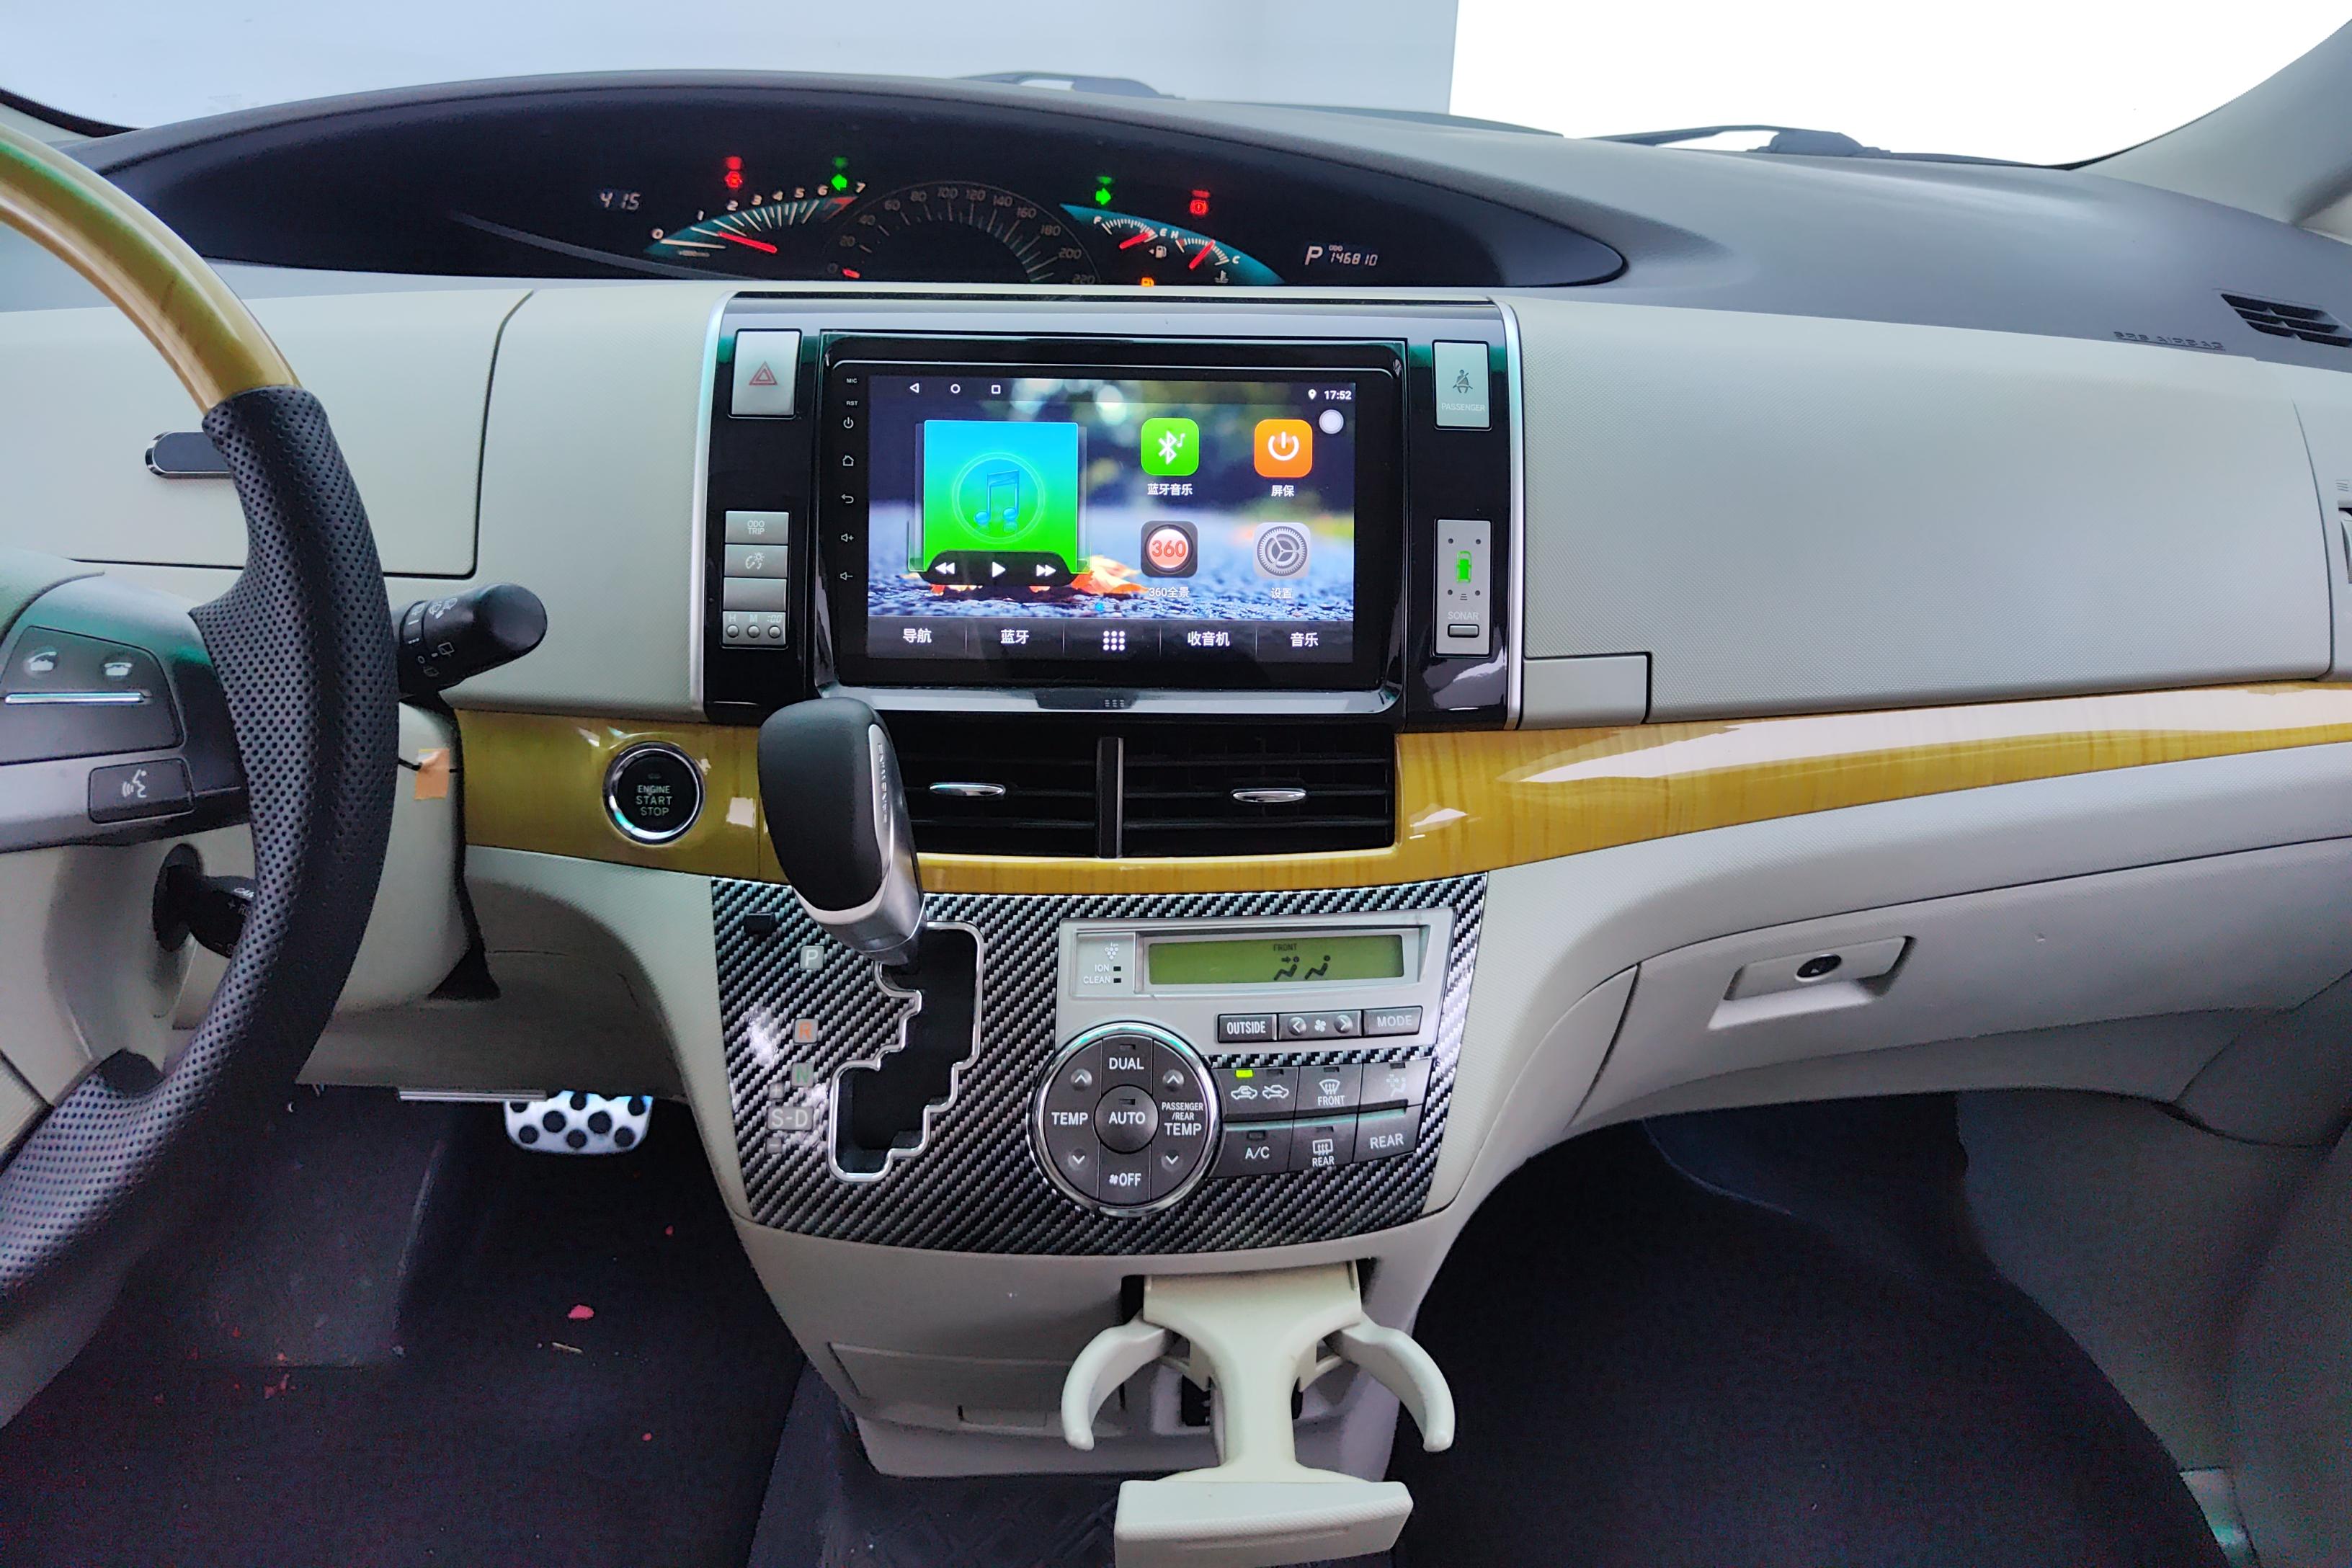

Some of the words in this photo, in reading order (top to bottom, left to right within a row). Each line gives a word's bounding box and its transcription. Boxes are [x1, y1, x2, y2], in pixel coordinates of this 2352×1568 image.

[651, 228, 664, 240] 0
[697, 210, 705, 221] 1
[726, 200, 739, 211] 2
[751, 195, 762, 205] 3
[772, 190, 783, 201] 4
[794, 187, 805, 198] 5
[817, 184, 829, 196] 6
[855, 182, 865, 193] 7
[1093, 216, 1102, 225] F
[1159, 228, 1167, 237] E
[839, 235, 856, 247] 20
[858, 215, 876, 226] 40
[884, 199, 901, 211] 60
[910, 190, 927, 202] 80
[937, 187, 958, 200] 100
[966, 189, 986, 201] 120
[992, 195, 1013, 208] 140
[1016, 207, 1037, 219] 160
[1040, 224, 1061, 236] 180
[1059, 247, 1082, 259] 200
[1072, 274, 1096, 285] 220
[1170, 231, 1180, 239] H
[1231, 256, 1241, 264] C
[1304, 246, 1324, 265] P
[1324, 390, 1352, 400] 17:52
[1441, 403, 1486, 411] PASSENGER
[1147, 483, 1193, 496] 蓝牙音乐
[1271, 485, 1295, 496] 屏保
[747, 520, 765, 528] ODO
[1152, 540, 1187, 558] 360
[1149, 587, 1190, 598] 360全景
[1270, 587, 1293, 600] 设置
[729, 614, 736, 623] H
[749, 614, 758, 623] M
[1448, 610, 1480, 620] SONAR
[903, 628, 932, 644] 导航
[1000, 629, 1030, 644] 蓝牙
[1187, 631, 1231, 647] 收音机
[1290, 632, 1319, 648] 音乐
[637, 785, 671, 793] ENGINE
[636, 796, 673, 806] START
[640, 806, 669, 816] STOP
[805, 949, 819, 967] P
[1083, 975, 1110, 984] CLEAN
[1226, 1020, 1266, 1035] OUTSIDE
[1377, 1015, 1412, 1027] MODE
[798, 1023, 811, 1039] R
[1109, 1057, 1144, 1070] DUAL
[796, 1066, 810, 1082] N
[1162, 1102, 1203, 1111] PASSENGER
[1317, 1095, 1345, 1106] FRONT
[1051, 1112, 1088, 1126] TEMP
[1108, 1111, 1146, 1125] AUTO
[1172, 1112, 1195, 1121] /REAR
[1164, 1123, 1202, 1136] TEMP
[1370, 1133, 1404, 1149] REAR
[1245, 1146, 1270, 1159] A/C
[1312, 1156, 1335, 1167] REAR
[1119, 1173, 1141, 1187] OFF
